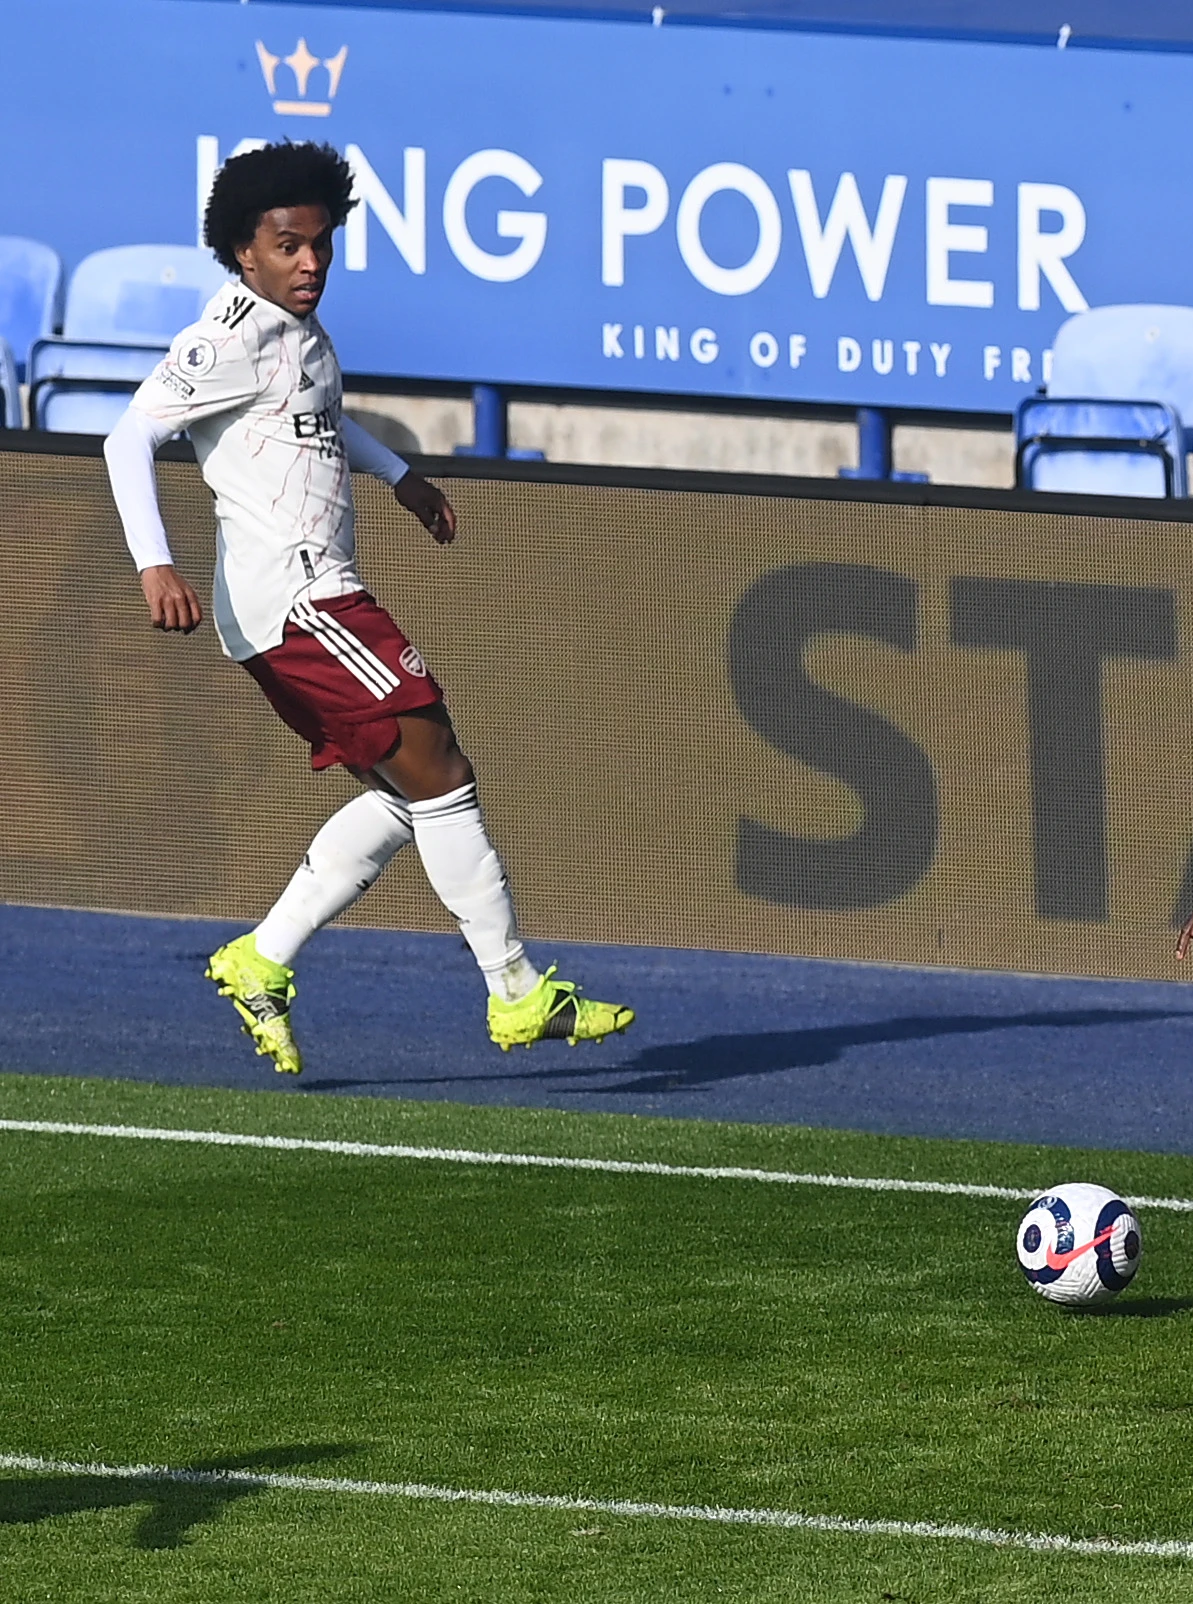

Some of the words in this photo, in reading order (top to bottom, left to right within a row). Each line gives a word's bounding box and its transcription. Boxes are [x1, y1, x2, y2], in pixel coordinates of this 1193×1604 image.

[602, 157, 1090, 314] POWER
[602, 323, 720, 364] KING
[749, 331, 807, 369] OF
[837, 336, 952, 378] DUTY
